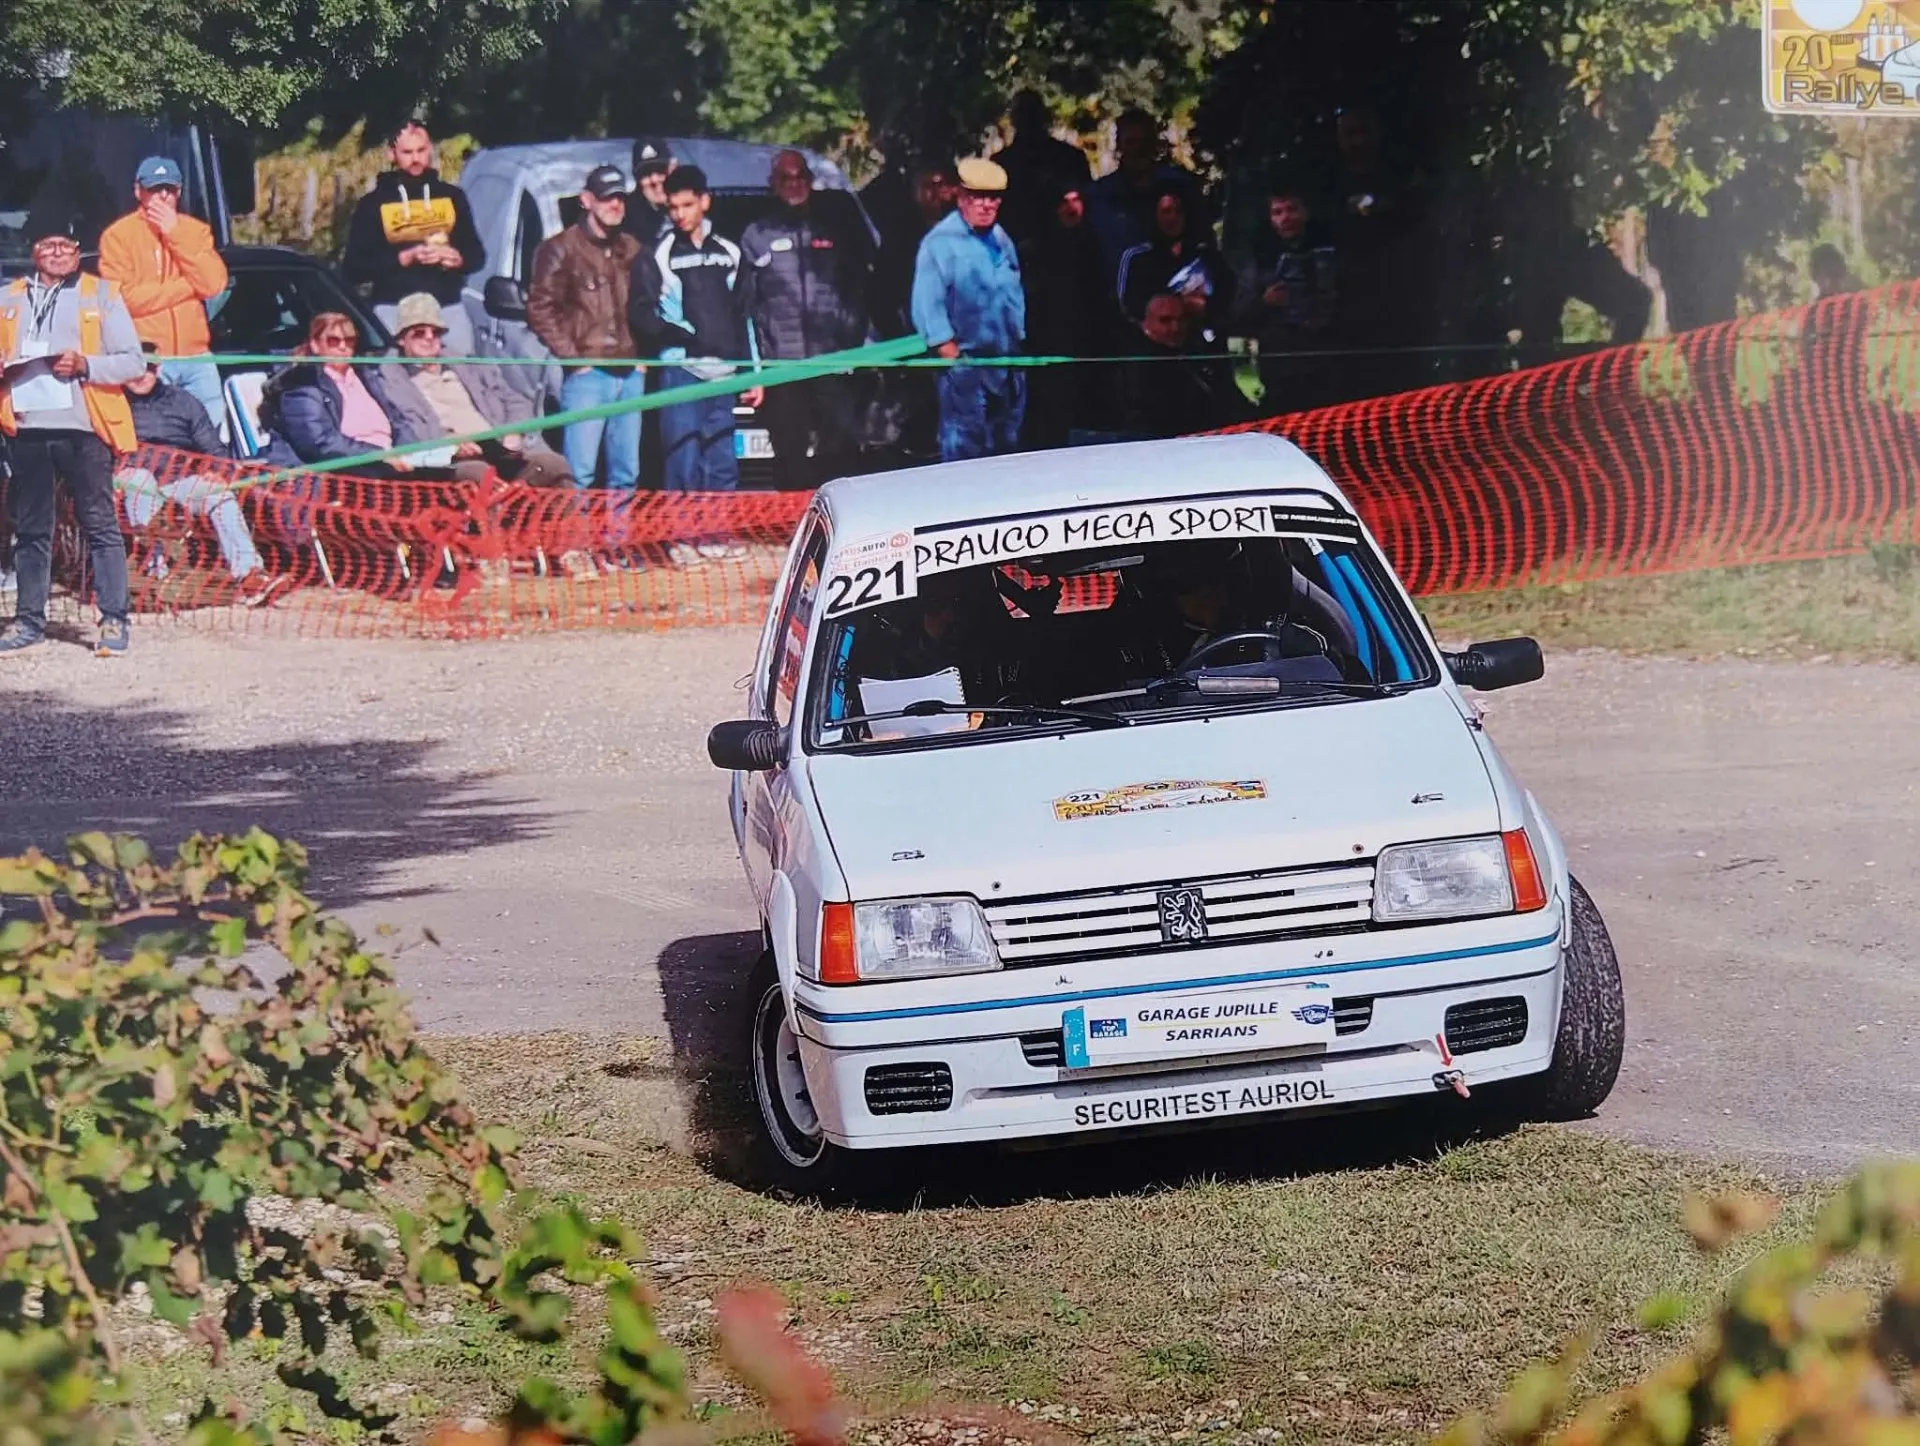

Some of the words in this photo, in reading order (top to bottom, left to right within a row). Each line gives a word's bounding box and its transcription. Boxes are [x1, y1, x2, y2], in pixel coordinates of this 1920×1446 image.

[1063, 511, 1154, 544] MECA
[1169, 507, 1268, 535] SPORT
[826, 560, 904, 615] 221
[1069, 793, 1101, 803] 221
[1137, 1006, 1210, 1022] GARAGE
[1214, 1001, 1279, 1018] JUPILLE
[1092, 1030, 1125, 1038] GARAGE
[1102, 1025, 1117, 1033] TOP
[1165, 1025, 1258, 1042] SARRIANS
[1072, 1043, 1081, 1056] F
[1074, 1090, 1231, 1126] SECURITEST
[1239, 1079, 1335, 1109] AURIOL
